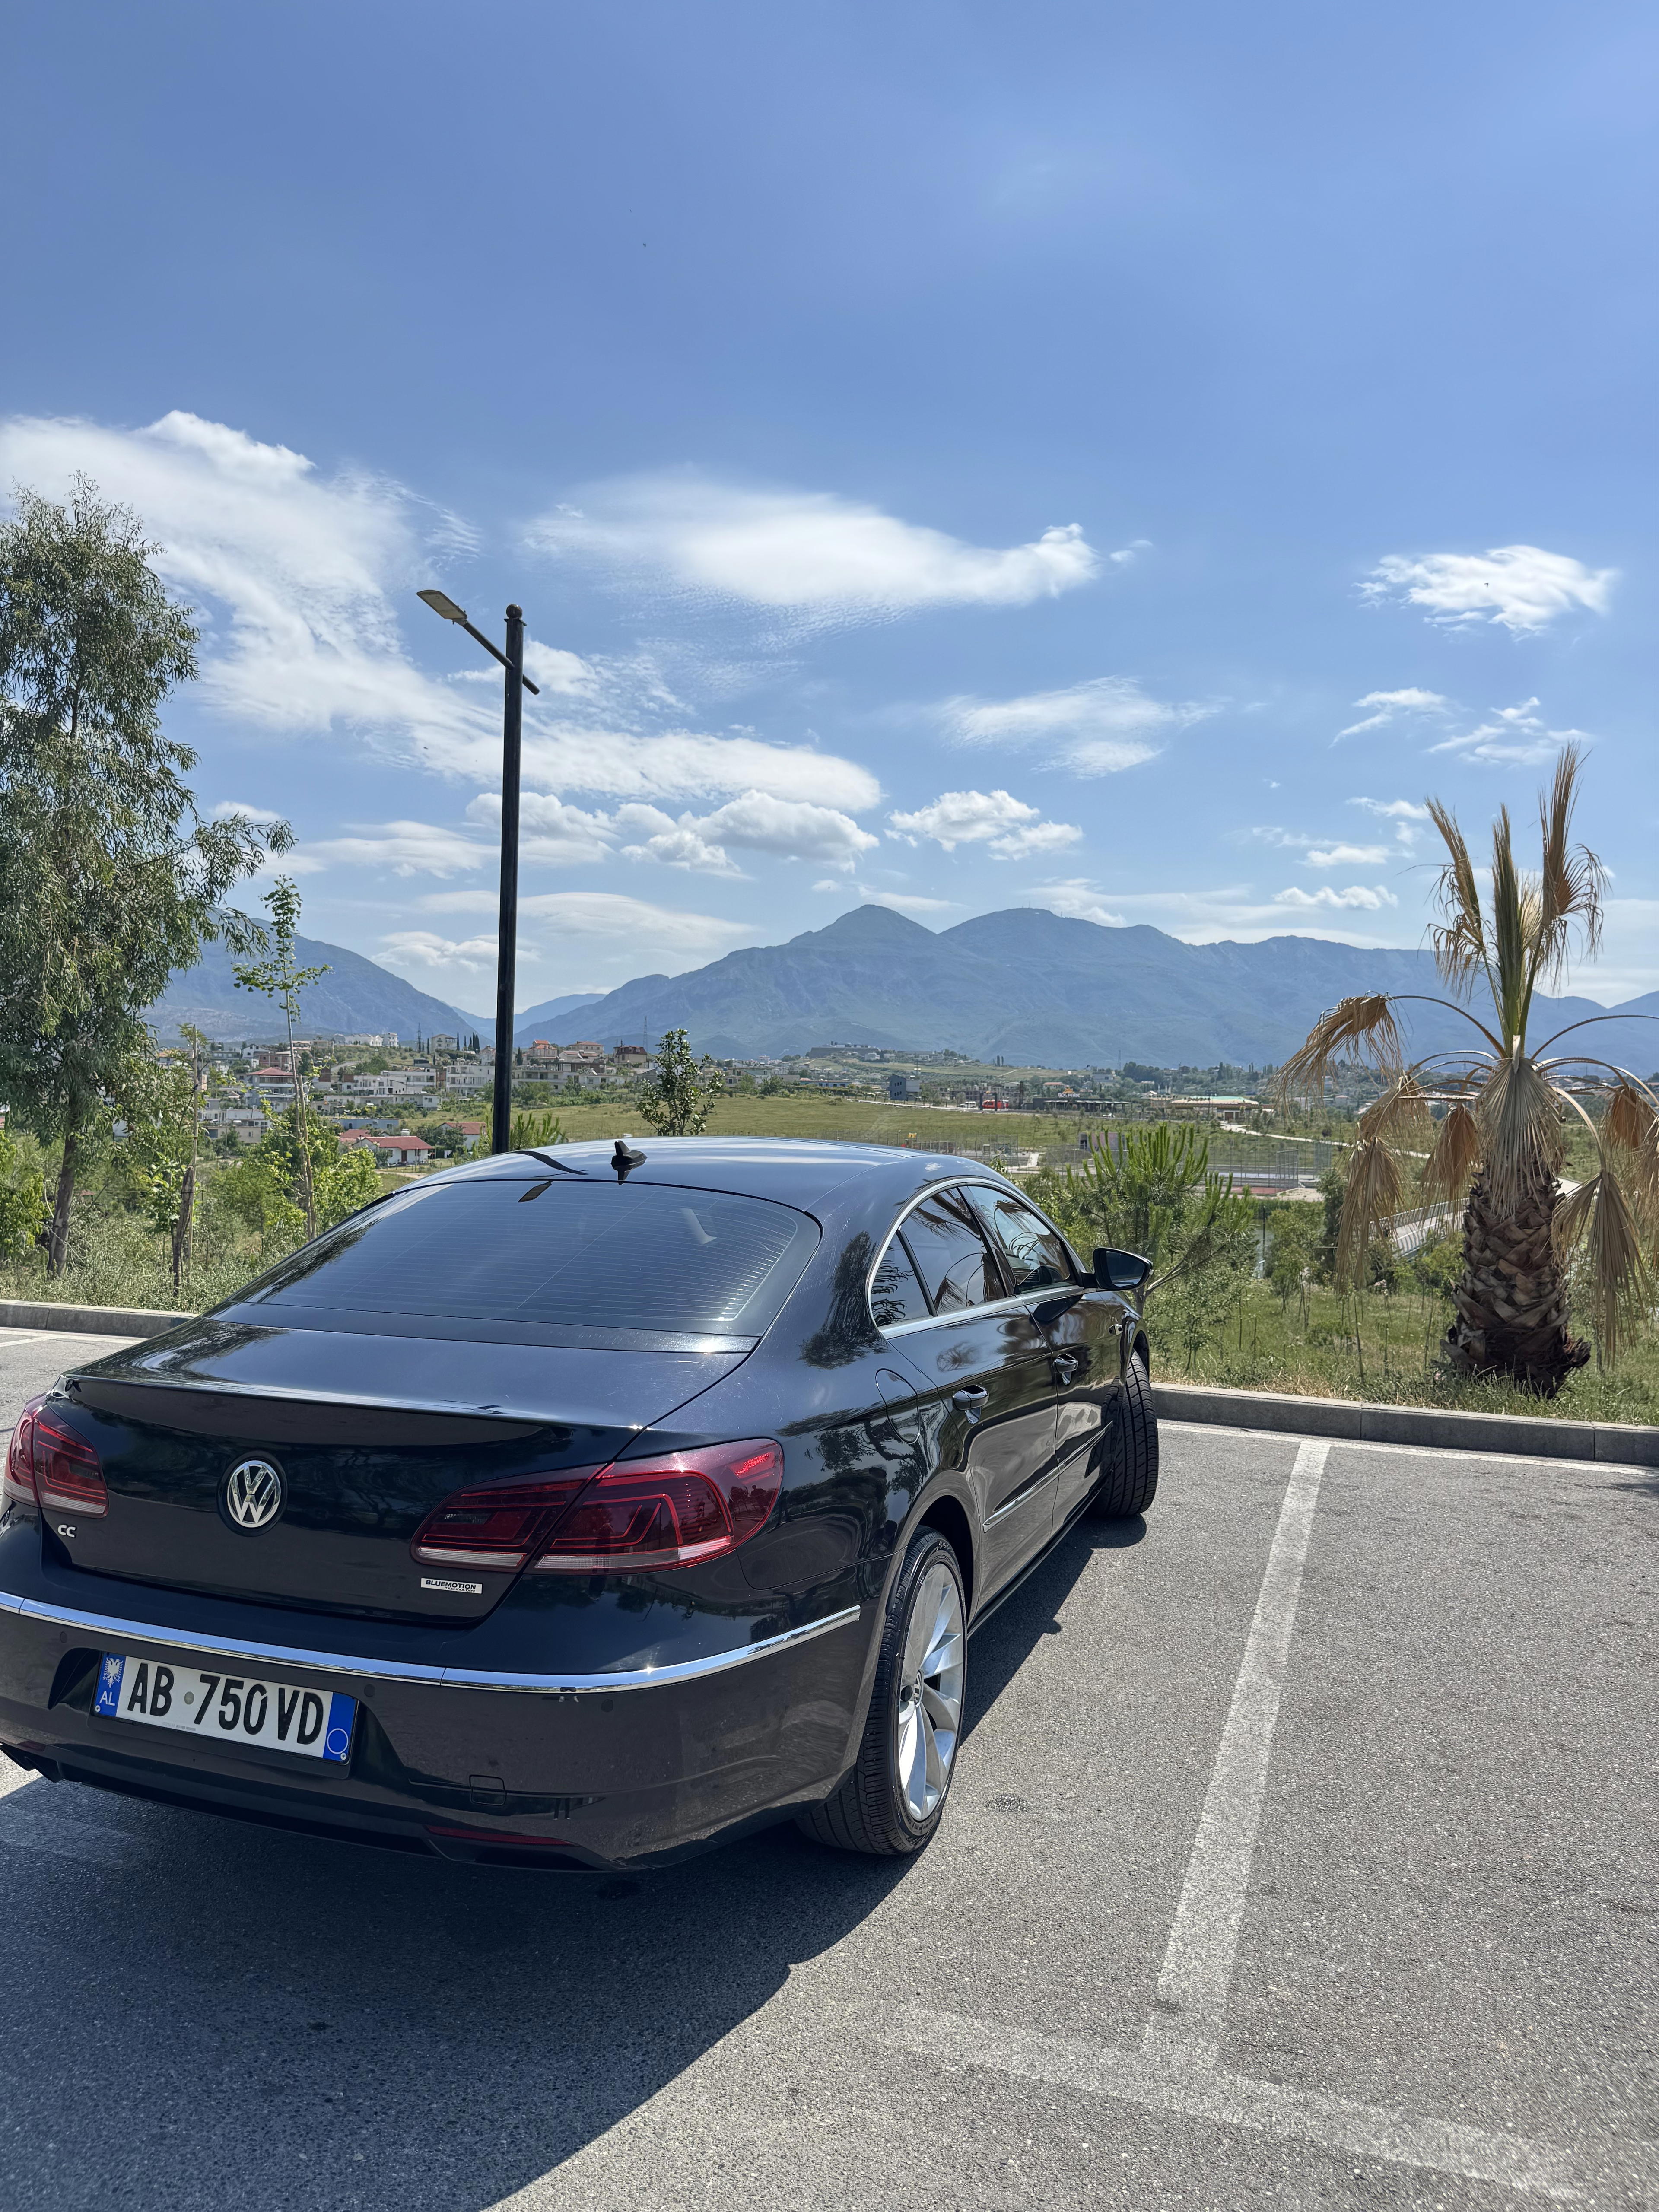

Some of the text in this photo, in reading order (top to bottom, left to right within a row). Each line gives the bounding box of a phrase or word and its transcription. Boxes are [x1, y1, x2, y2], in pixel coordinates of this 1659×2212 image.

[229, 1462, 279, 1526] VW
[58, 1525, 76, 1538] CC
[426, 1580, 476, 1589] BLUEMOTION
[127, 1663, 174, 1716] AB
[99, 1691, 115, 1706] AL
